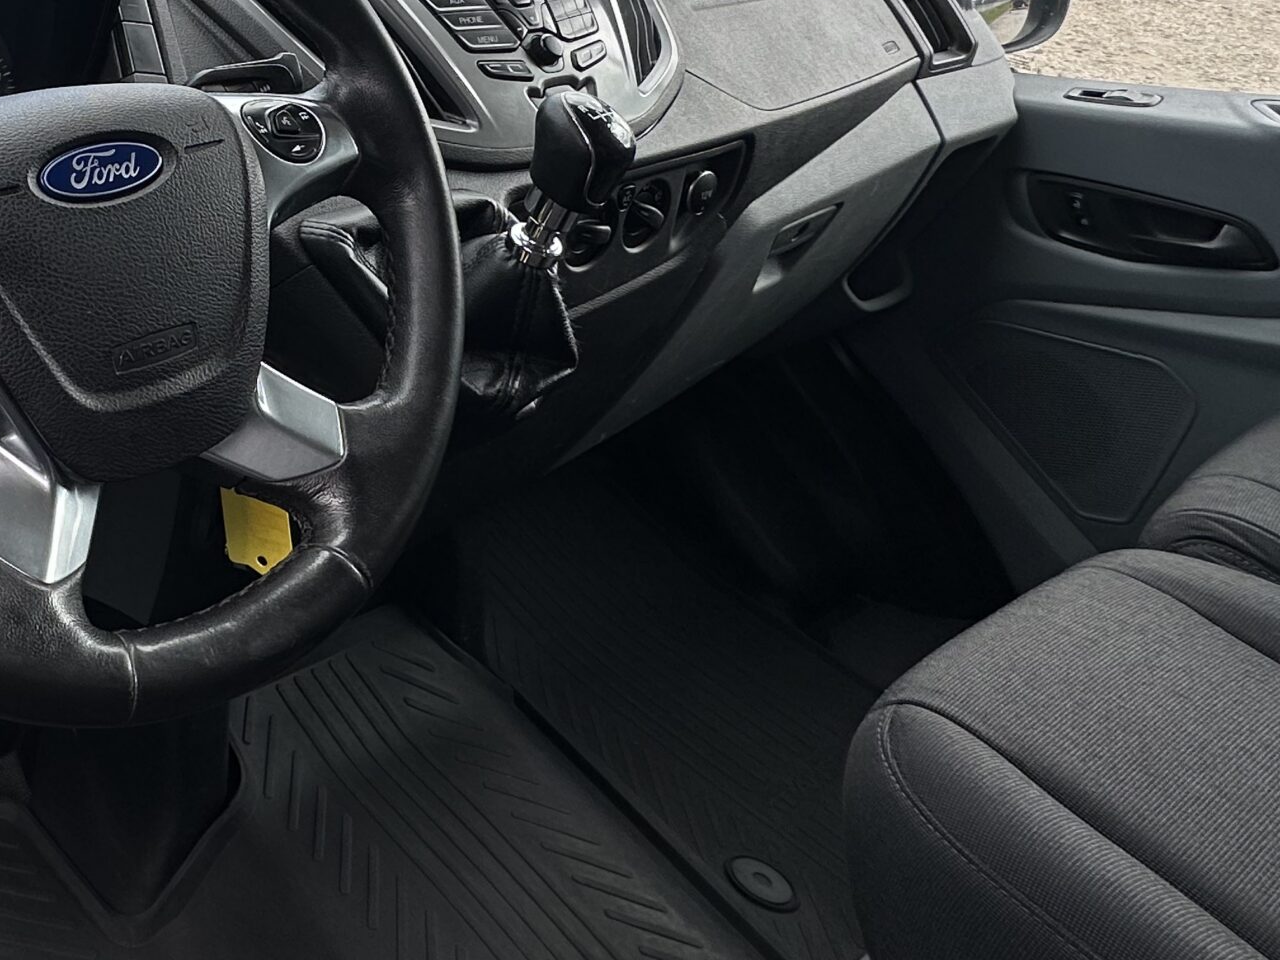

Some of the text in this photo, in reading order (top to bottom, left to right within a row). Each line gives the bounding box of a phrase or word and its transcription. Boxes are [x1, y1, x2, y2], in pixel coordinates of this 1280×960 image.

[458, 16, 484, 24] PHONE
[476, 35, 499, 44] MENU
[70, 148, 140, 190] Ford
